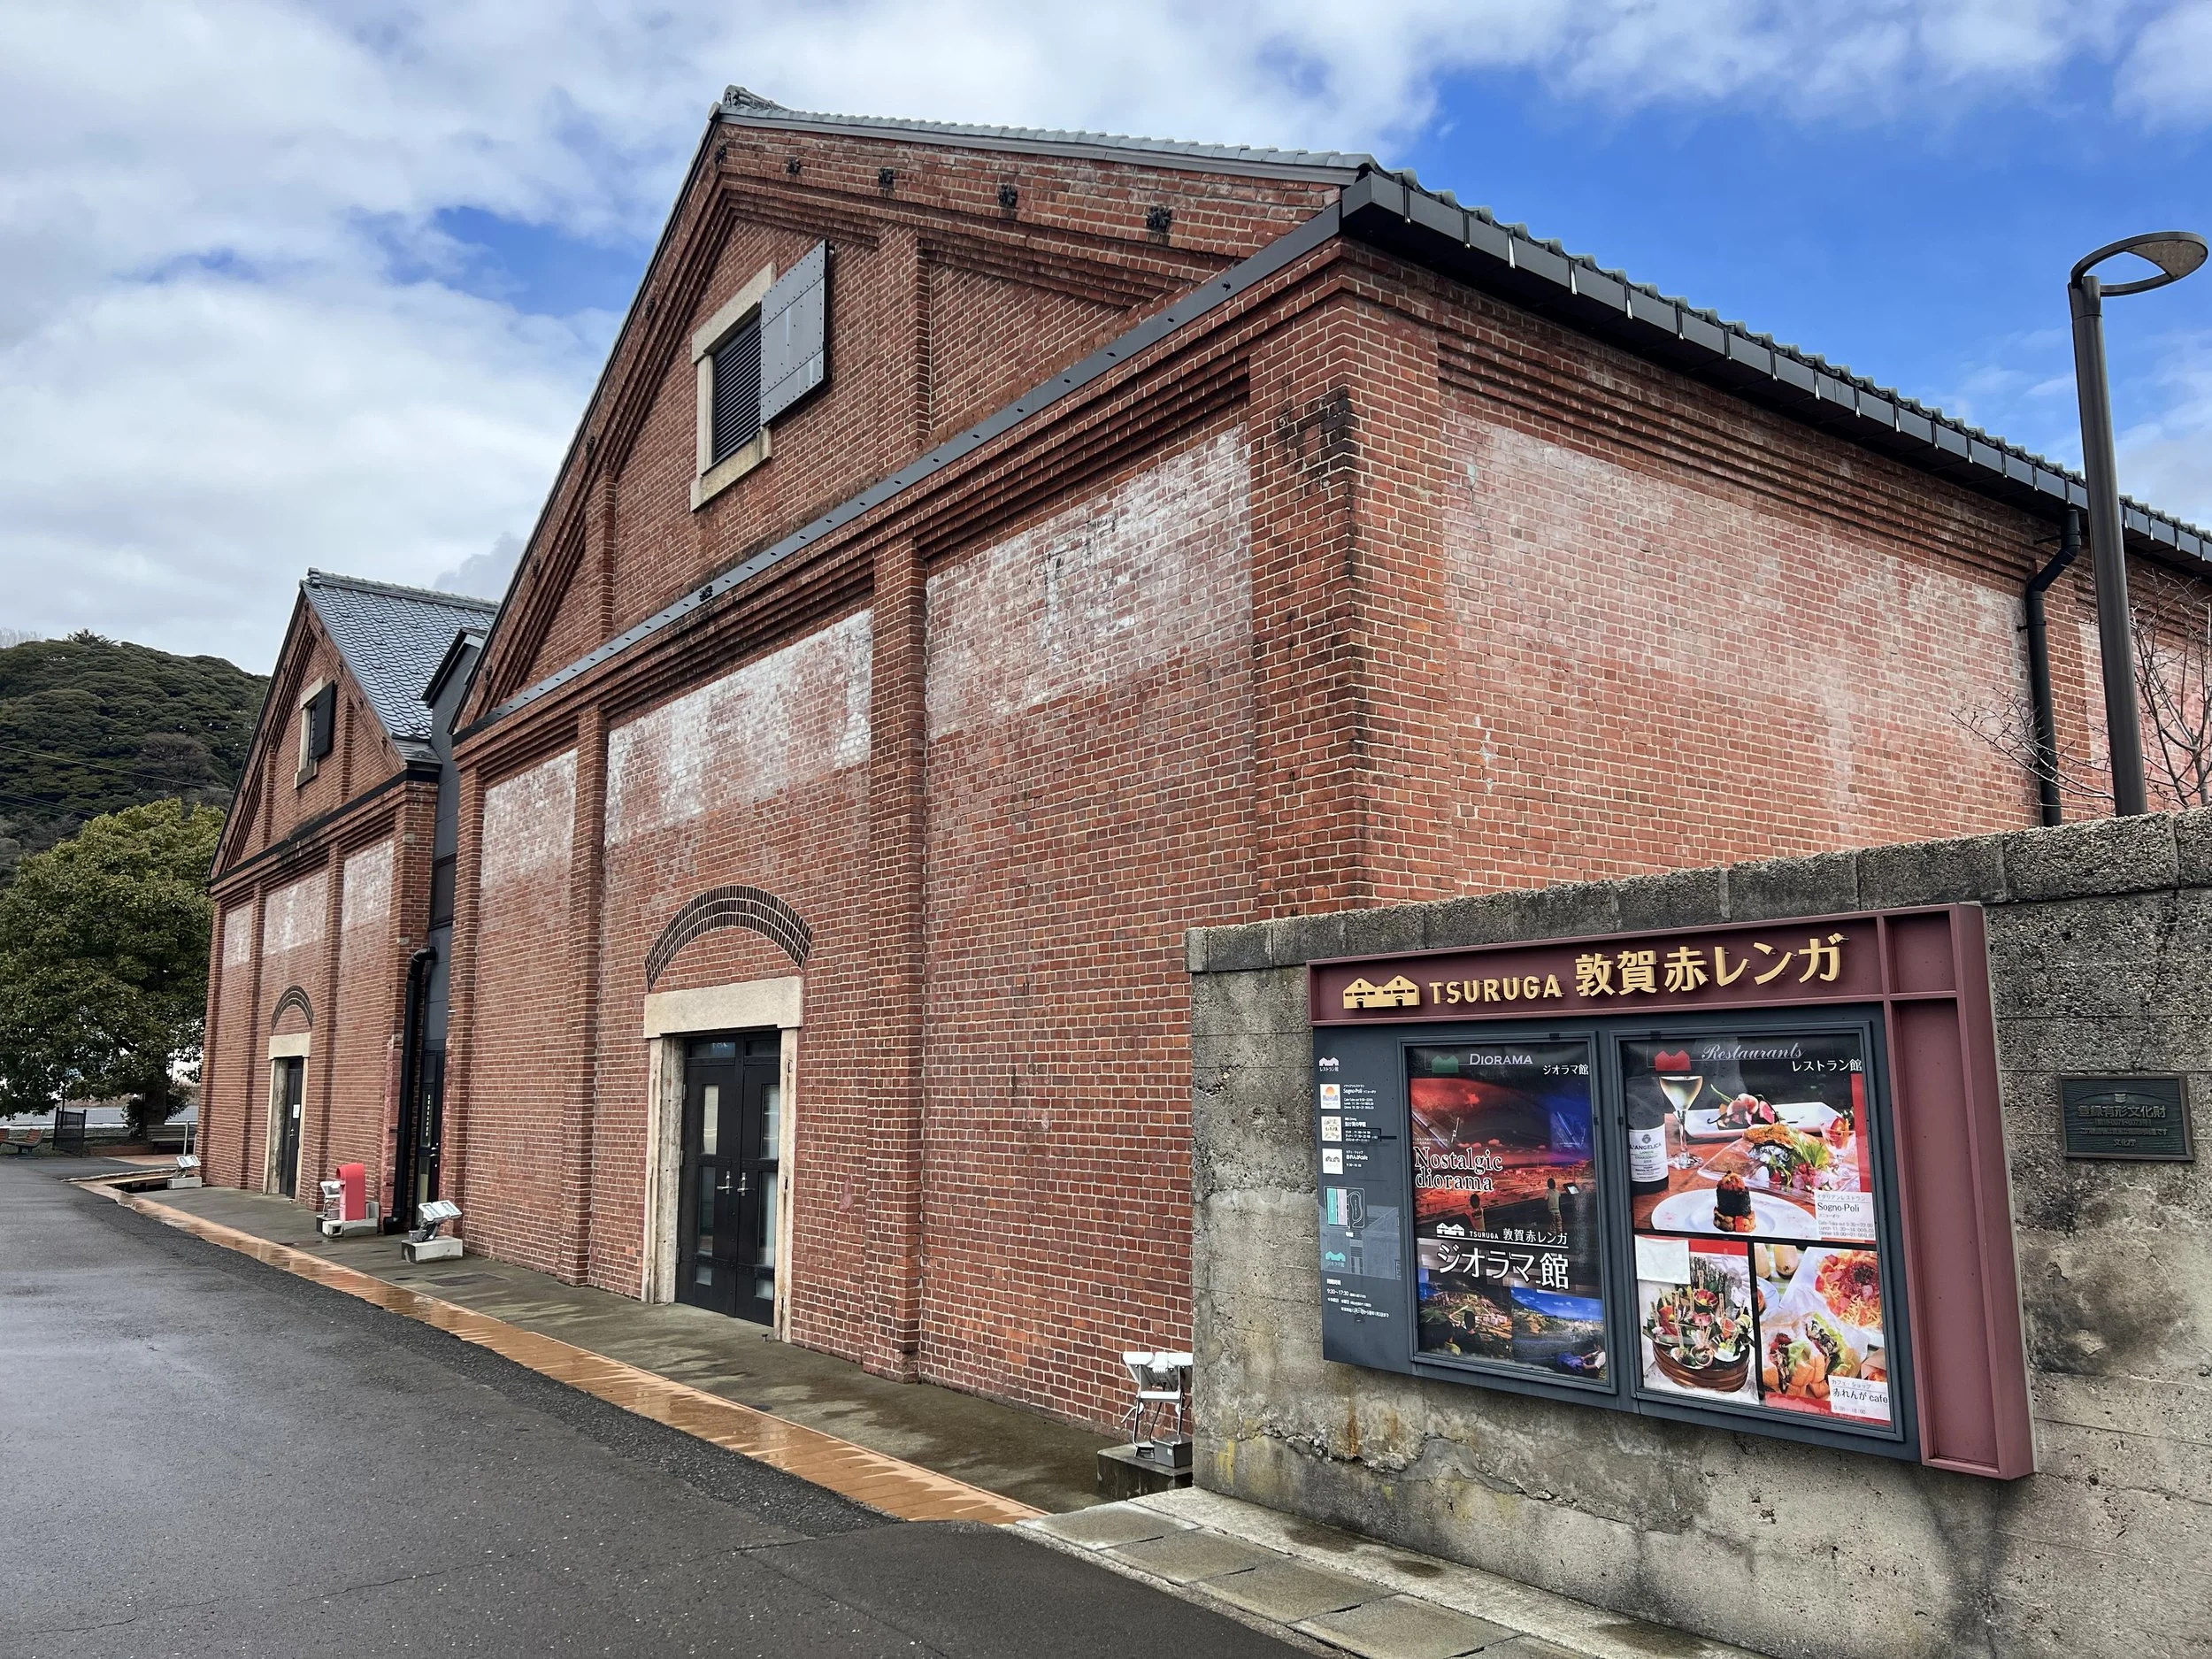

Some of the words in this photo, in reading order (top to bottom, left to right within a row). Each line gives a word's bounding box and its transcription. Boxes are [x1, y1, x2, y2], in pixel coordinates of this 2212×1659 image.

[1429, 974, 1563, 1005] TSURUGA
[1575, 933, 1847, 997] 敦賀赤レンガ
[1469, 1053, 1533, 1065] DIORAMA
[1701, 1042, 1806, 1061] Restaurants
[1542, 1064, 1589, 1075] ジオラマ館
[1792, 1058, 1863, 1072] レストラン館
[2078, 1104, 2167, 1118] 登録有形文化財
[1413, 1146, 1503, 1174] Nostalgic
[1415, 1165, 1494, 1192] diorama
[1817, 1202, 1860, 1212] Sogno-Poli
[1469, 1231, 1499, 1240] TSURUGA
[1503, 1227, 1569, 1246] 敦賀赤レンガ
[1437, 1242, 1570, 1289] ジオラマ館
[1833, 1387, 1867, 1401] 赤れんが
